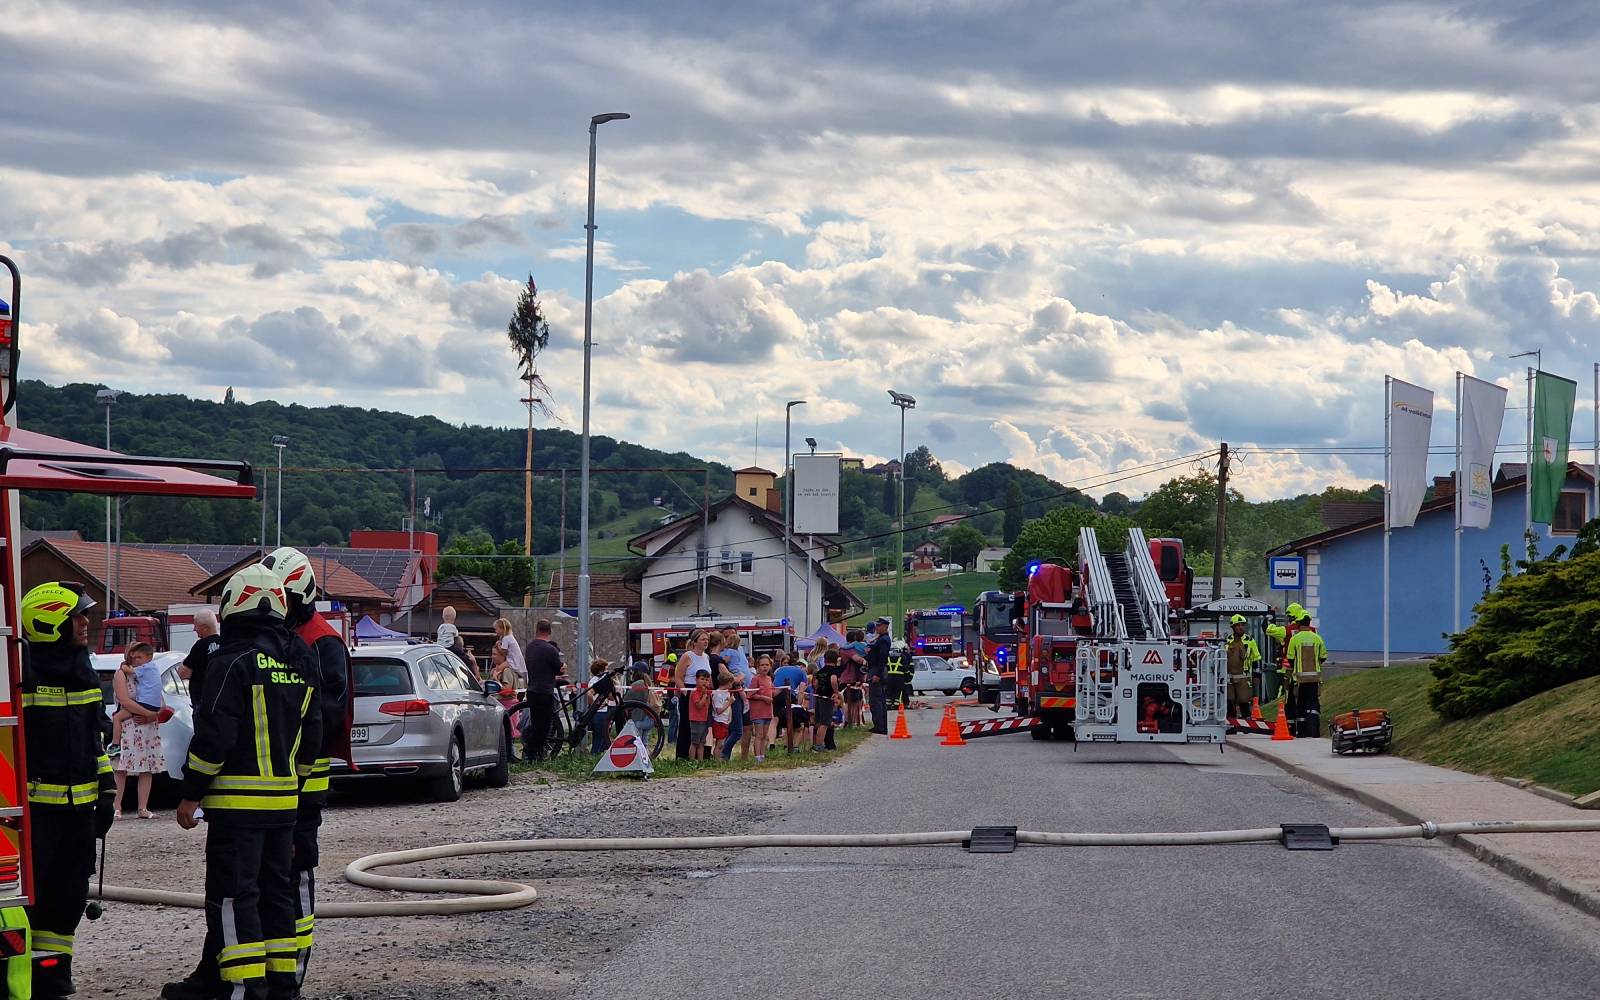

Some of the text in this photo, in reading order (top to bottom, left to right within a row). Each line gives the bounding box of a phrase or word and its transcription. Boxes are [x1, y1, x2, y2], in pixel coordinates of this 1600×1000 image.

[1229, 603, 1258, 611] VOLIČINA
[1130, 673, 1175, 681] MAGIRUS
[351, 728, 367, 738] 899
